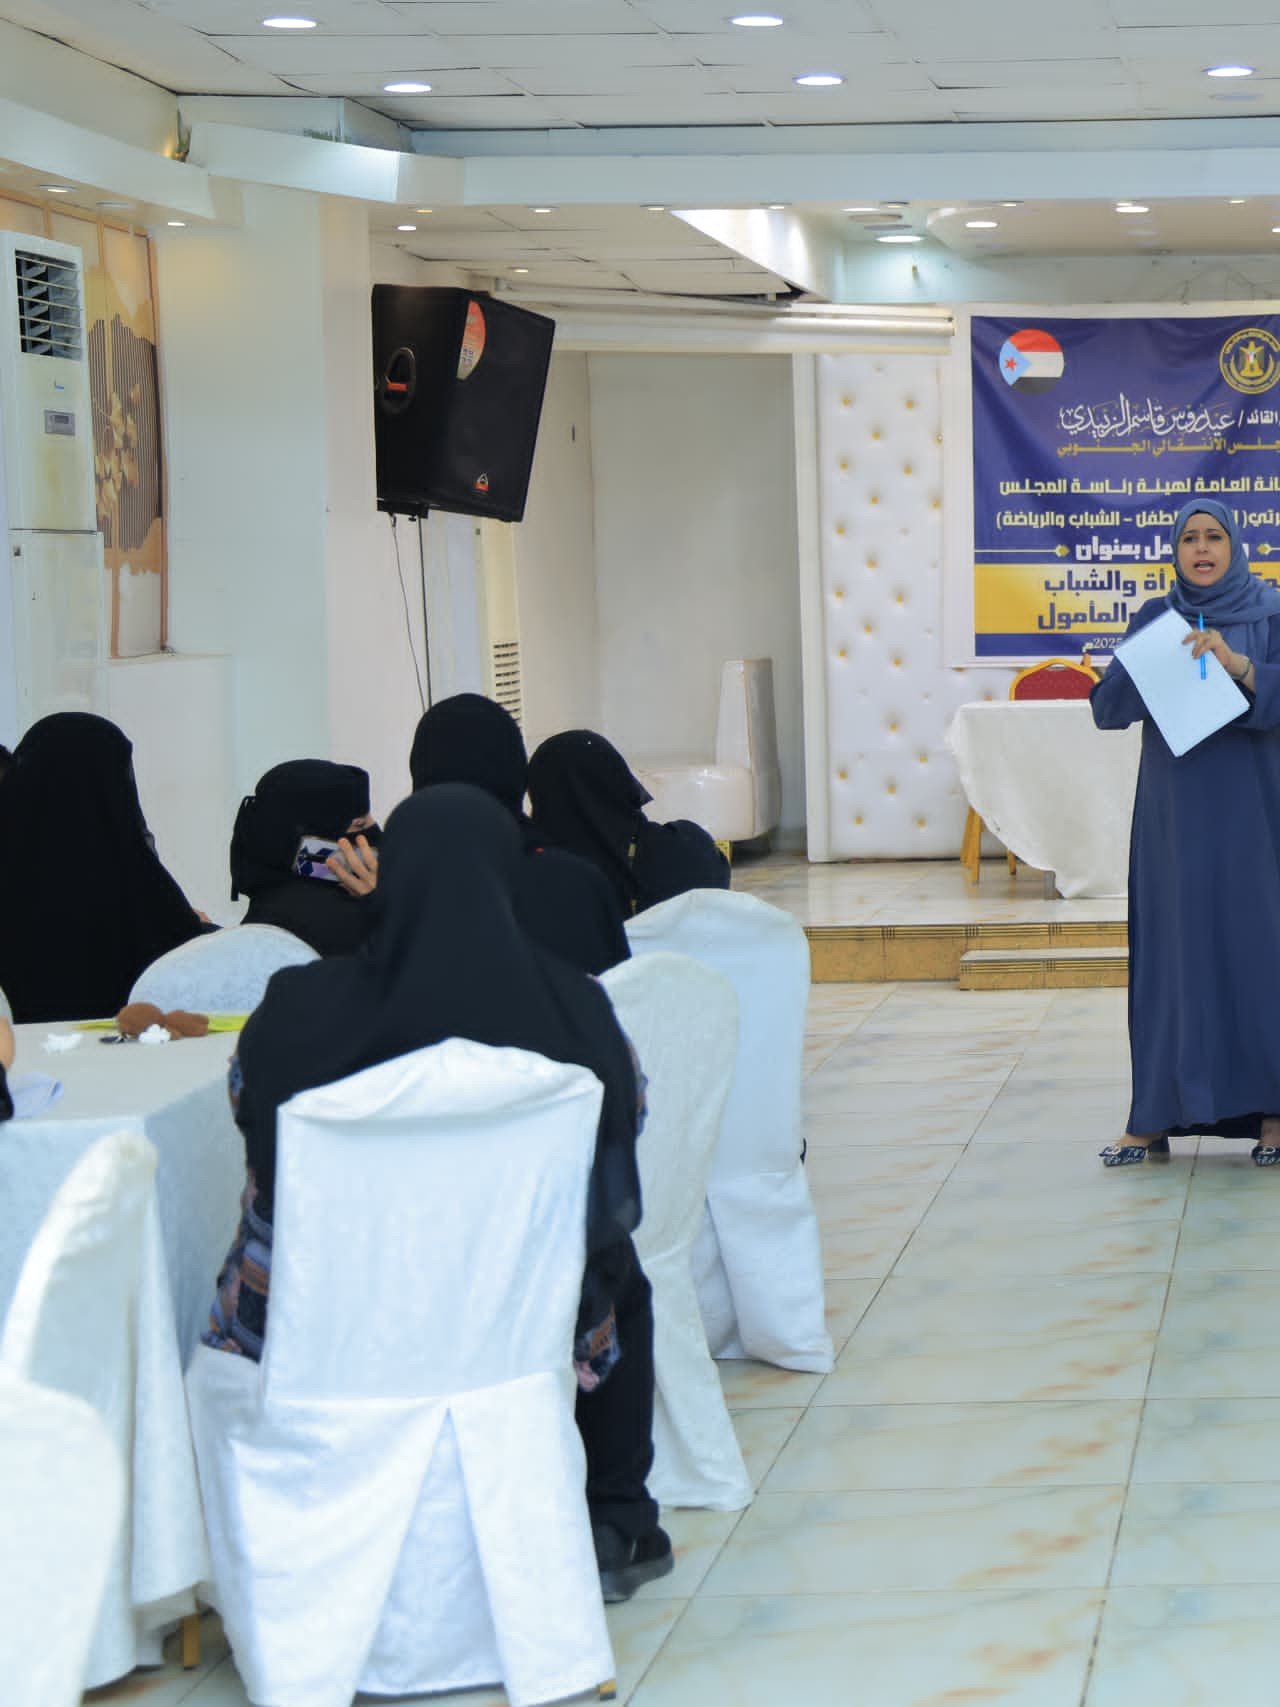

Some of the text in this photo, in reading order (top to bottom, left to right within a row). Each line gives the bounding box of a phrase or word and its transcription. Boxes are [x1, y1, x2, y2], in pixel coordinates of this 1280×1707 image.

[999, 478, 1067, 497] المجلس
[1195, 477, 1251, 493] العامة
[1069, 508, 1120, 529] الشباب
[1075, 535, 1141, 561] بعنوان
[1044, 568, 1137, 597] والشباب
